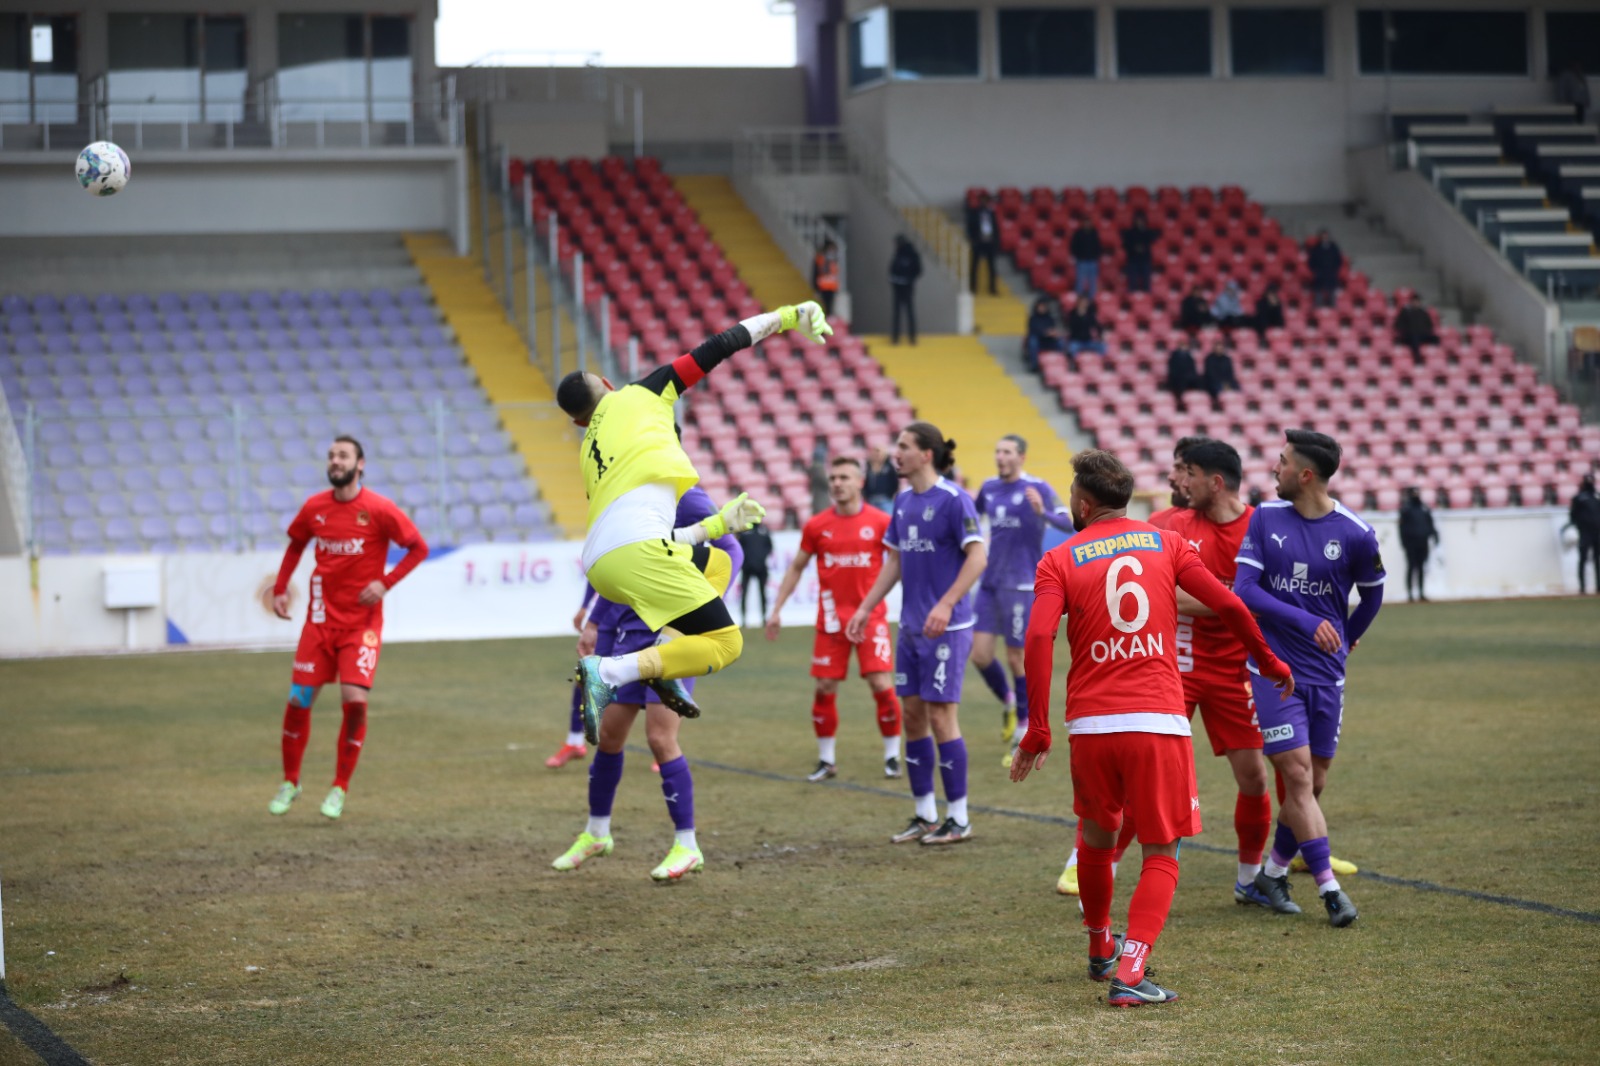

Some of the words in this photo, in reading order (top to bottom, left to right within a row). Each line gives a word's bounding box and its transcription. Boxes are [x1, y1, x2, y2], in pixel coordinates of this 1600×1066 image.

[1074, 533, 1159, 563] FERPANEL
[1105, 555, 1150, 634] 6
[356, 645, 377, 670] 20
[1090, 632, 1164, 663] OKAN
[934, 660, 947, 684] 4
